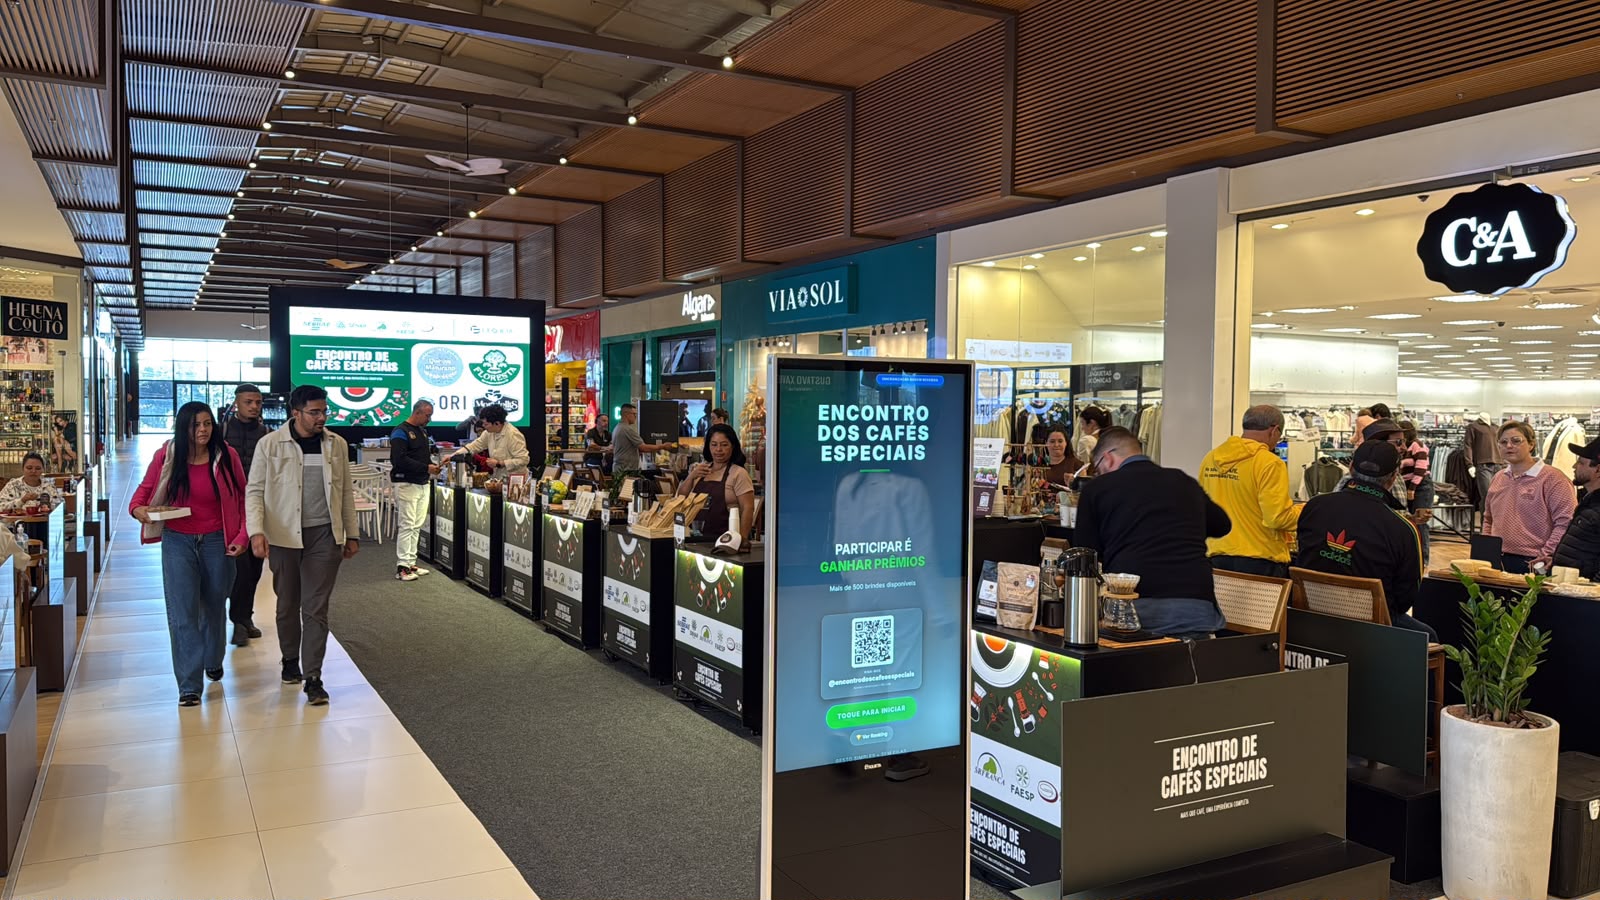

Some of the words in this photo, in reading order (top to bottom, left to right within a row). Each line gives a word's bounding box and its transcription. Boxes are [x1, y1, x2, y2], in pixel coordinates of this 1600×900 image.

[1440, 210, 1537, 267] C&A
[769, 288, 797, 312] VIA
[810, 280, 844, 307] SOL
[9, 302, 63, 320] HELENA
[8, 316, 64, 335] COUTO
[315, 349, 373, 361] ENCONTRO
[375, 351, 389, 362] DE
[343, 361, 399, 372] ESPECIAIS
[473, 366, 517, 381] FLORESTA
[439, 395, 466, 410] ORI
[818, 404, 929, 421] ENCONTRO
[817, 425, 860, 441] DOS
[866, 419, 930, 441] CAFÉS
[821, 445, 926, 461] ESPECIAIS
[1356, 484, 1384, 498] adidas
[835, 541, 902, 555] PARTICIPAR
[904, 537, 912, 551] É
[820, 558, 872, 573] GANHAR
[874, 555, 926, 569] PRÊMIOS
[1319, 550, 1352, 566] adidas
[865, 582, 885, 590] brindes
[837, 711, 860, 719] TOQUE
[881, 705, 906, 714] INICIAR
[1173, 738, 1238, 771] ENCONTRO
[1242, 734, 1257, 758] DE
[1161, 766, 1201, 799] CAFÉS
[1206, 757, 1267, 790] ESPECIAIS
[1010, 784, 1035, 802] FAESP
[970, 808, 1007, 839] ENCONTRO
[1009, 828, 1020, 845] DE
[970, 824, 986, 844] AFÉS
[988, 834, 1026, 865] ESPECIAIS
